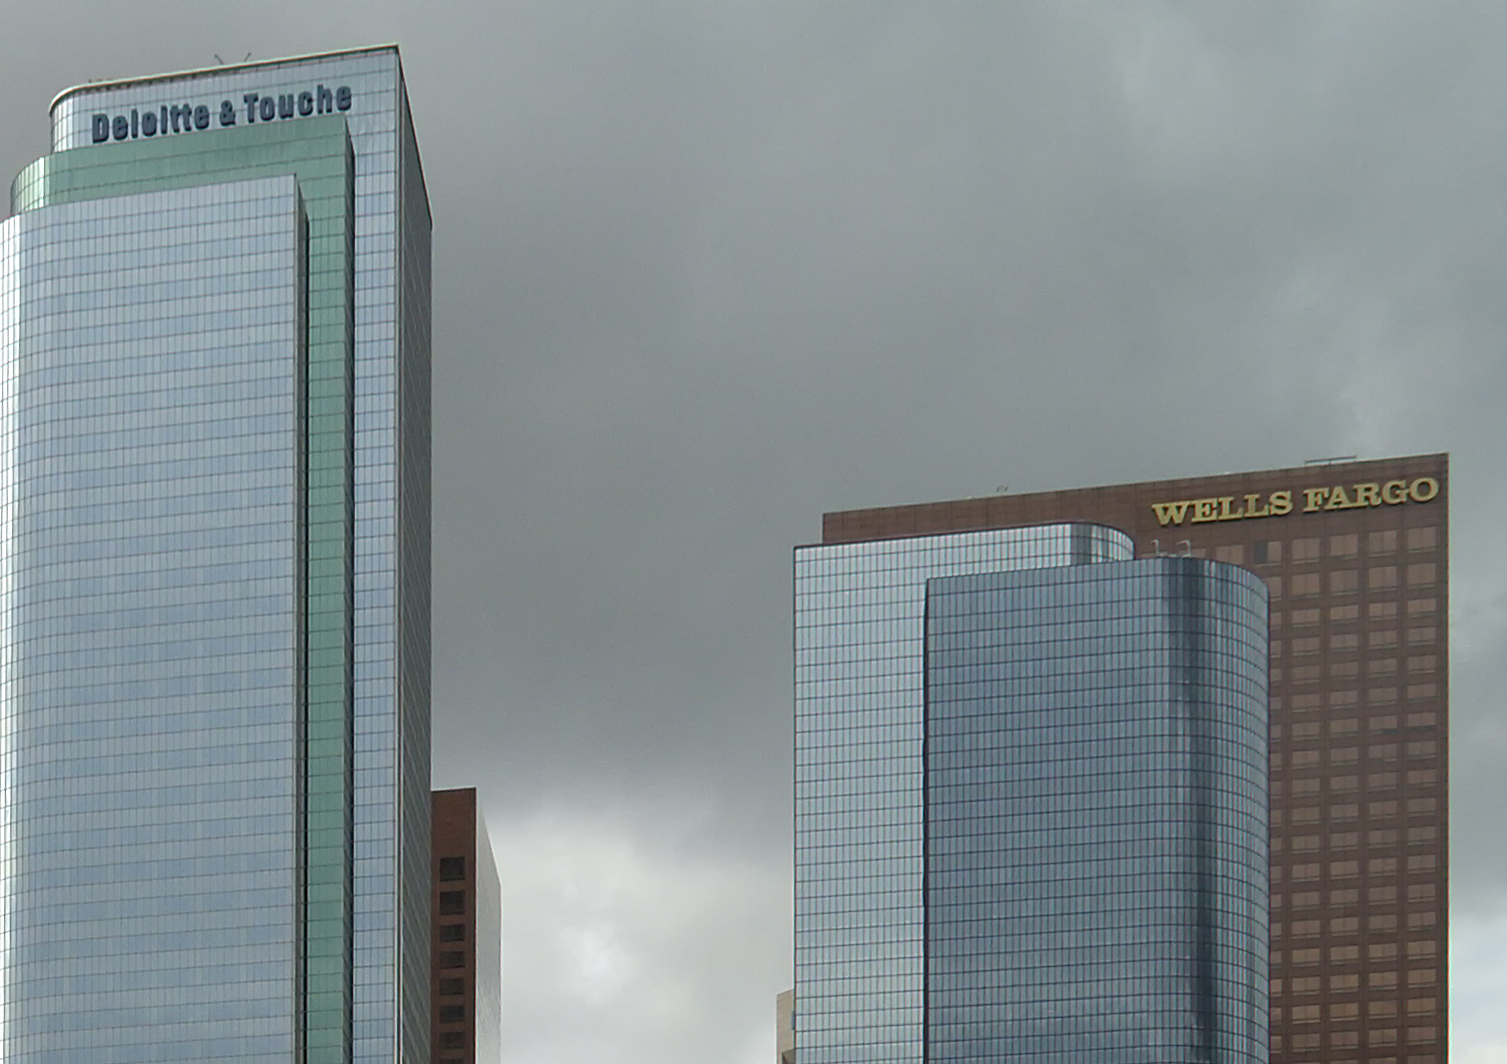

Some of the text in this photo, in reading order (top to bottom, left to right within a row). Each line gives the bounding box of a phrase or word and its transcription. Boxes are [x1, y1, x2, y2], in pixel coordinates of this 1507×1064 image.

[92, 83, 354, 144] Deloitte & Touche
[1152, 476, 1441, 527] WELLS FARGO
